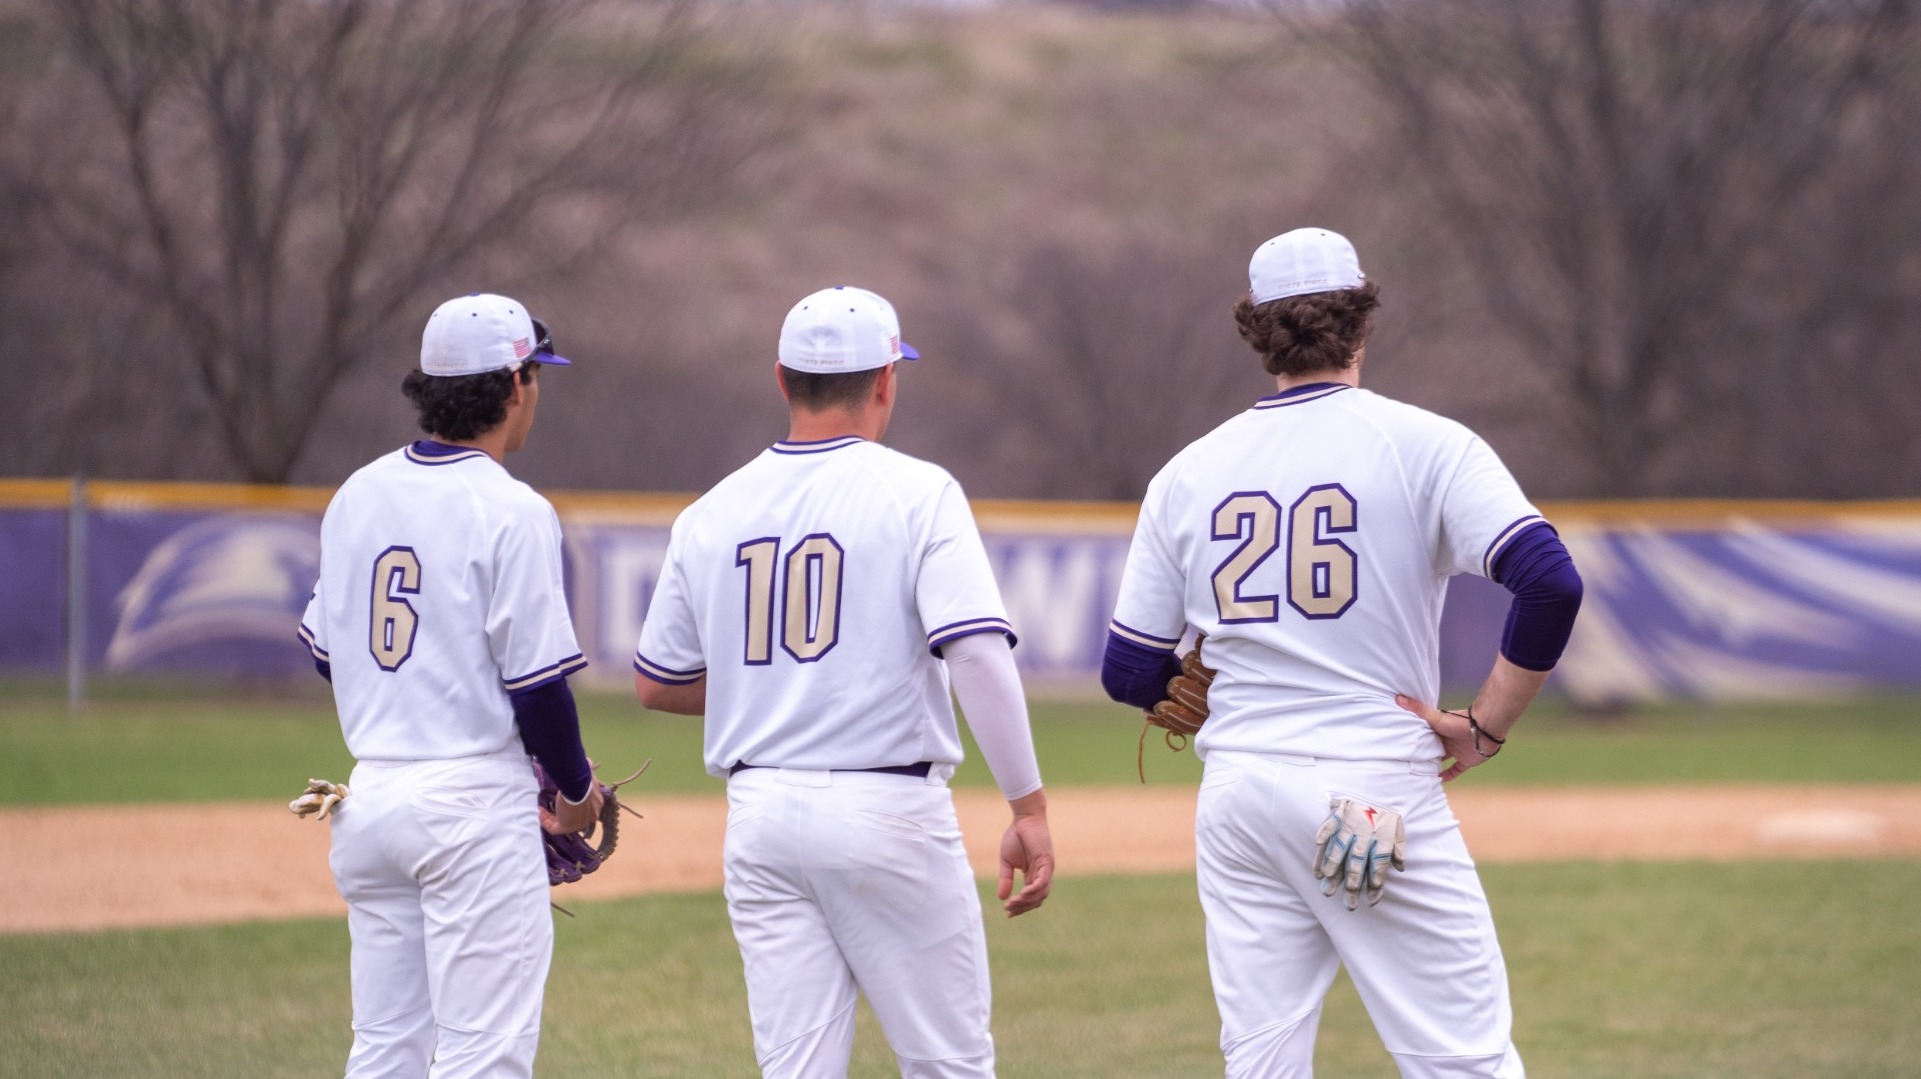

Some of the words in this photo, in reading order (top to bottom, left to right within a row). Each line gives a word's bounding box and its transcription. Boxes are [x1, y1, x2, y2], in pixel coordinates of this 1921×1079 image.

[369, 545, 421, 673] 6
[735, 532, 844, 666] 10
[1211, 483, 1358, 625] 26
